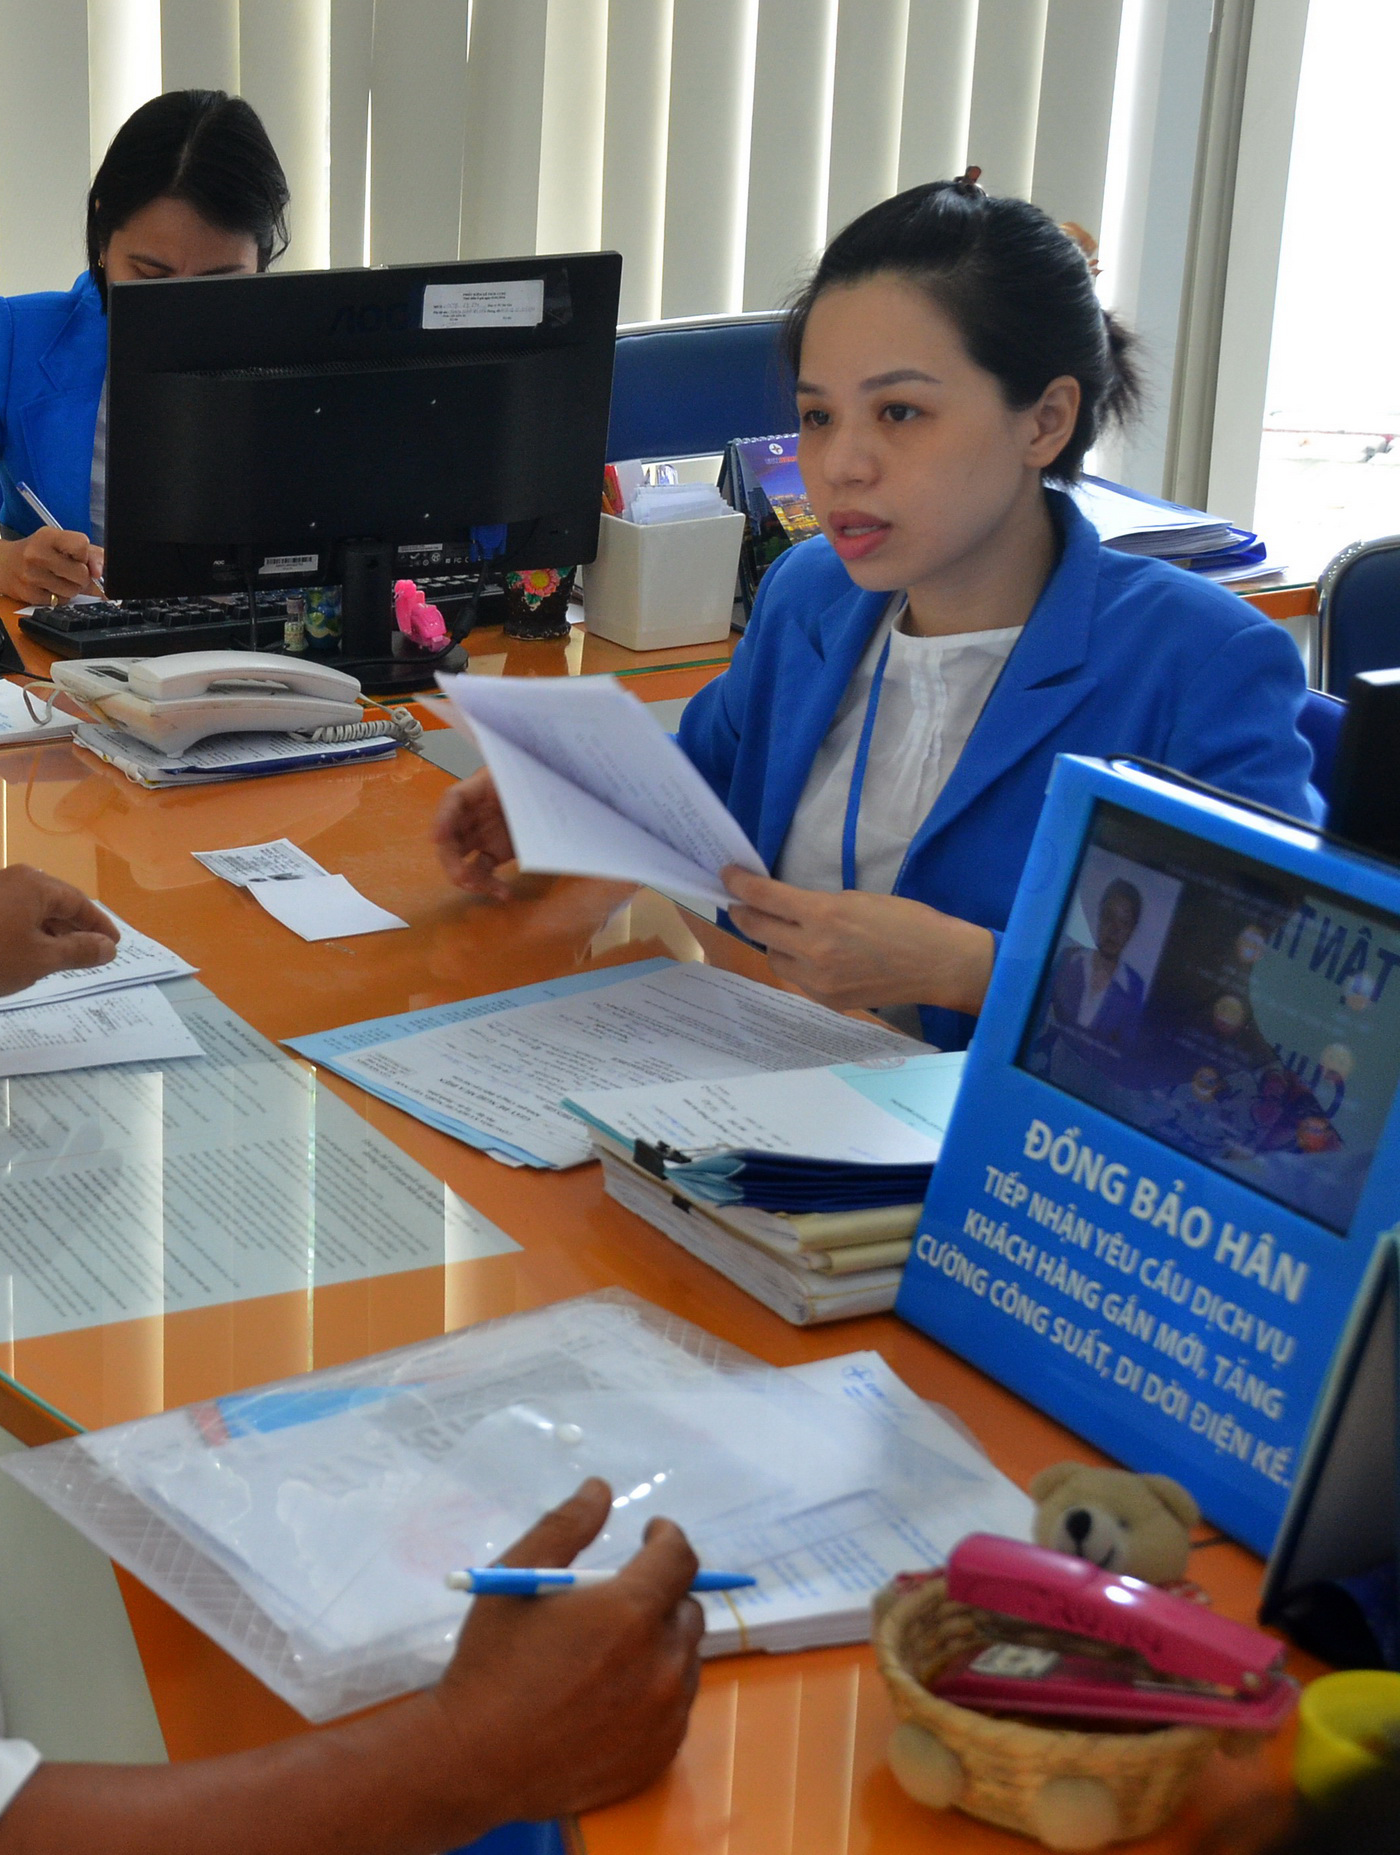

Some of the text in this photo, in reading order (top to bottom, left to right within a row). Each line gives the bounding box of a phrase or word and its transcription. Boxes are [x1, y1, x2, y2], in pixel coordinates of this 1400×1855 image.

[962, 1208, 1038, 1272] KHÁCH
[1035, 1250, 1103, 1312] HÀNG
[1213, 1354, 1285, 1421] TĂNG
[984, 1165, 1029, 1209] TIẾP
[1027, 1191, 1094, 1250] NHẬN
[1094, 1227, 1140, 1275] YÊU
[1190, 1285, 1256, 1343] DỊCH
[1255, 1320, 1297, 1370] VỤ
[1129, 1175, 1213, 1249] BẢO
[1213, 1222, 1309, 1304] HÂN
[916, 1233, 991, 1298] CƯỜNG
[989, 1279, 1053, 1336] CÔNG
[1113, 1354, 1145, 1394] DI
[1141, 1378, 1191, 1423] DỜI
[1189, 1400, 1255, 1461] ĐIỆN
